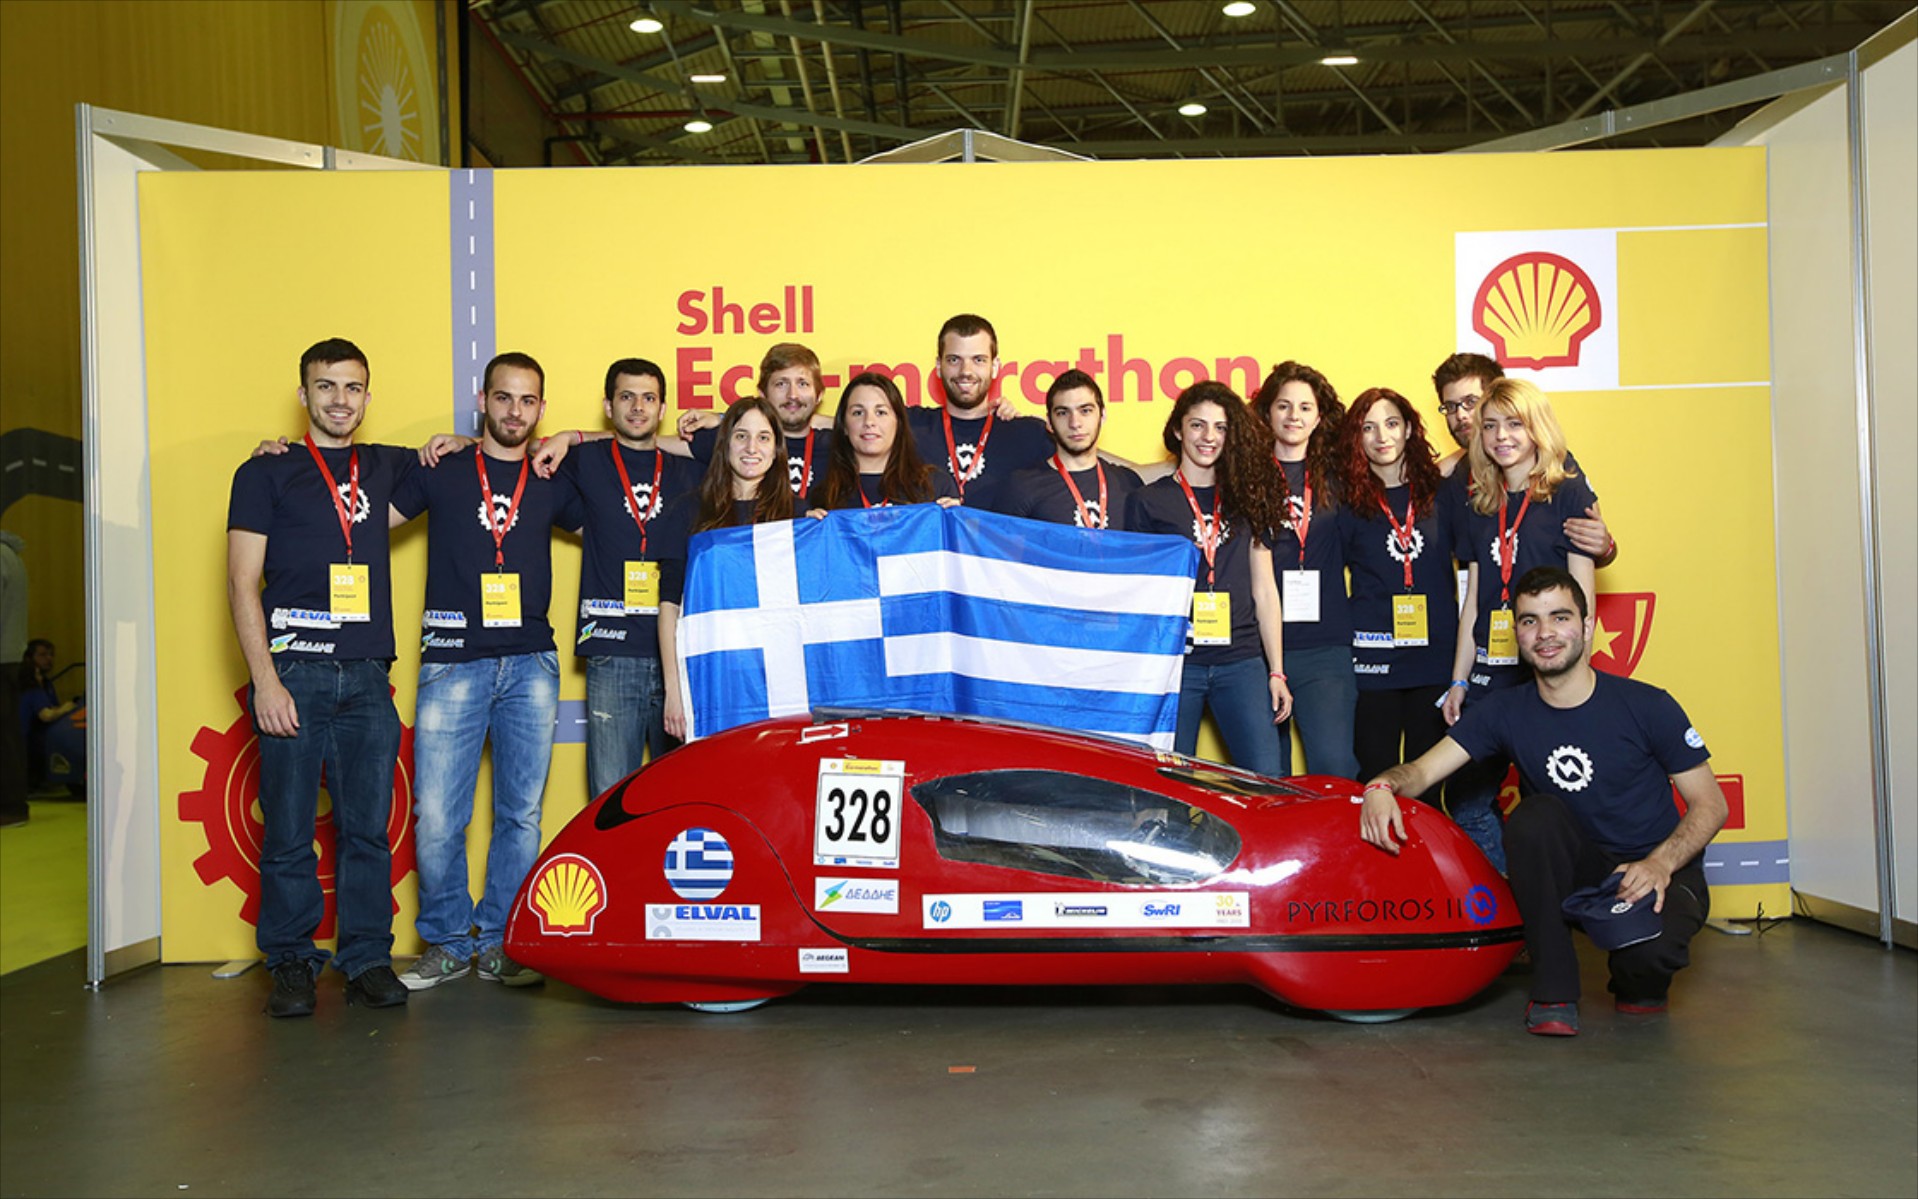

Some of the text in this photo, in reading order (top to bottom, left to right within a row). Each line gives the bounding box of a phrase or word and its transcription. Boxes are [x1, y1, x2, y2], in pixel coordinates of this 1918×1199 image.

[676, 285, 814, 335] Shell
[333, 575, 355, 585] 328
[485, 583, 506, 593] 328
[825, 787, 891, 844] 328
[675, 905, 757, 921] ELVAL
[932, 900, 950, 922] hp
[1143, 904, 1181, 917] SwRI
[1287, 897, 1463, 923] PYRFOROS II
[816, 954, 845, 962] AEGEAN
